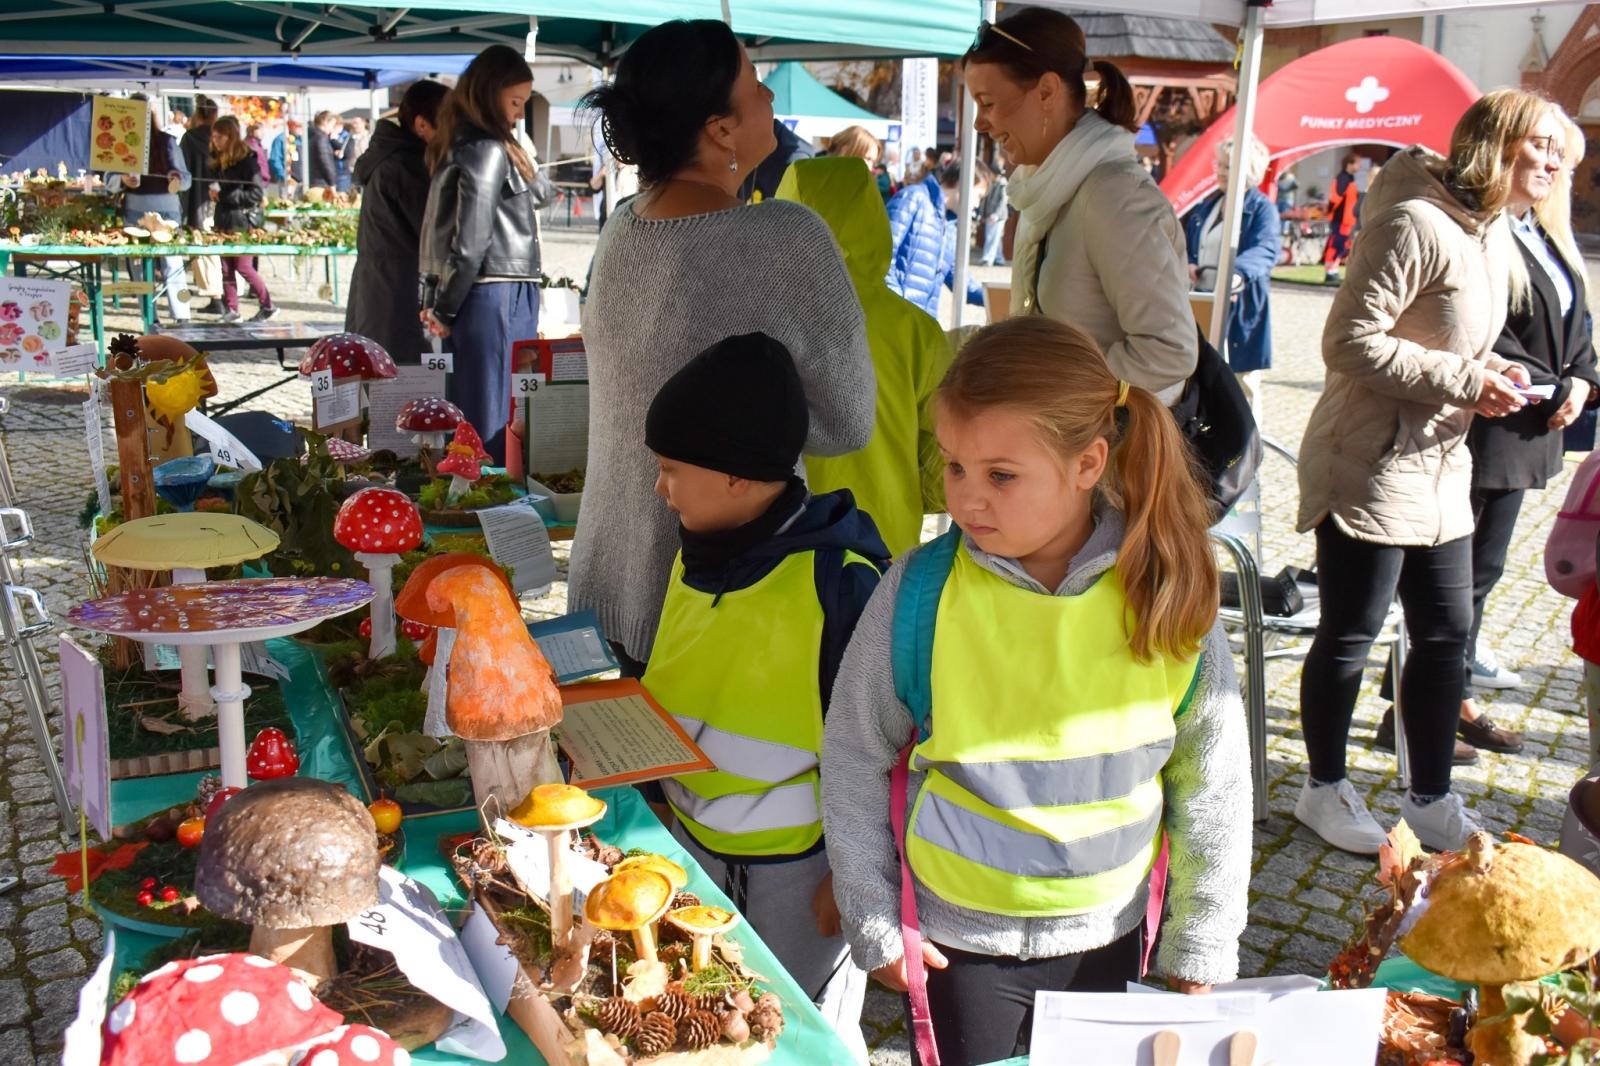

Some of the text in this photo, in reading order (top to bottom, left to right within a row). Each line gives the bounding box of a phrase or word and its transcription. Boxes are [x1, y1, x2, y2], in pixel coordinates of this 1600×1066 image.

[1300, 115, 1423, 129] PUNKT MEDYCZNY
[428, 358, 446, 371] 56
[317, 376, 329, 391] 35
[520, 378, 538, 392] 33
[217, 448, 231, 462] 49
